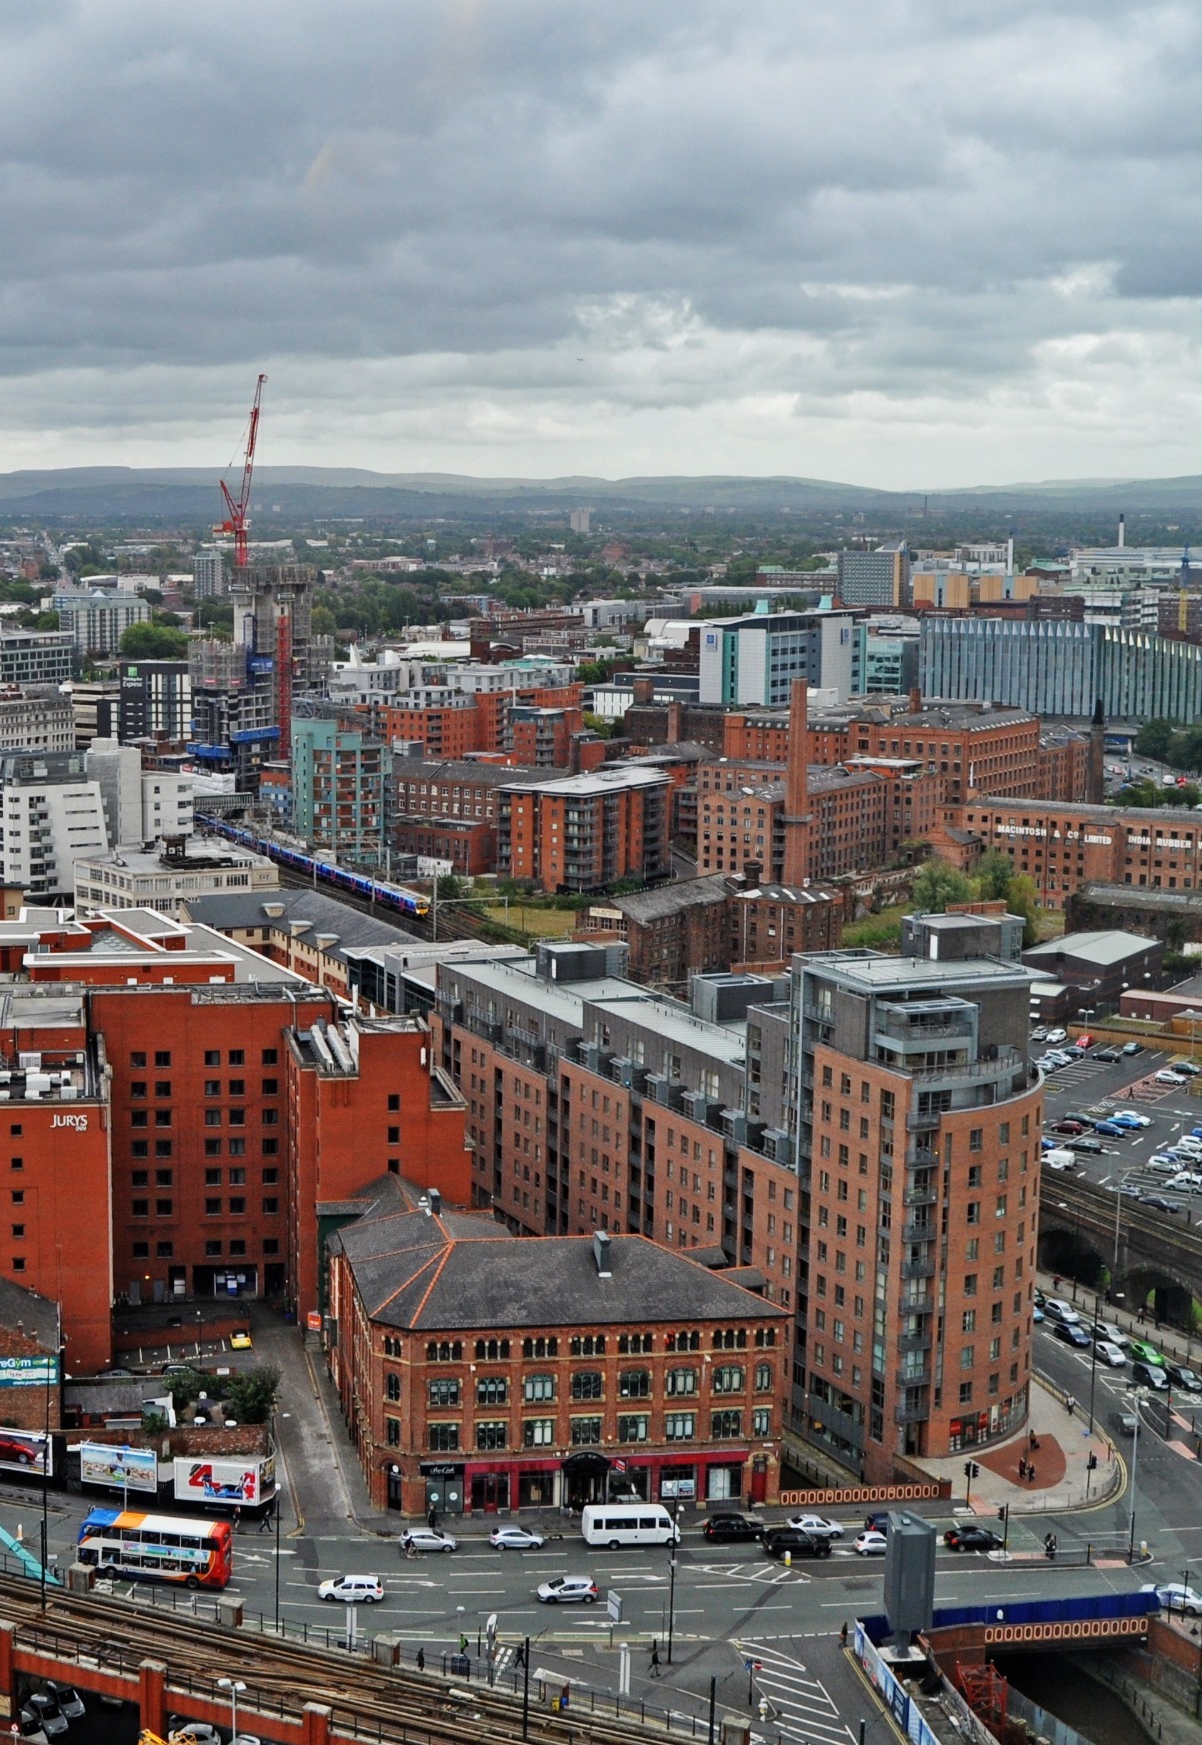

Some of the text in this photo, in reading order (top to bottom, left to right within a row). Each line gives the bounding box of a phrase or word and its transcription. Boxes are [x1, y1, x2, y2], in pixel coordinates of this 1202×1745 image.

[998, 825, 1047, 837] MACINTOSH
[1054, 830, 1060, 838] &
[1084, 834, 1112, 845] LIMITED
[1128, 835, 1151, 845] INDIA
[1156, 838, 1192, 849] RUBBER
[50, 1114, 88, 1128] JURYS
